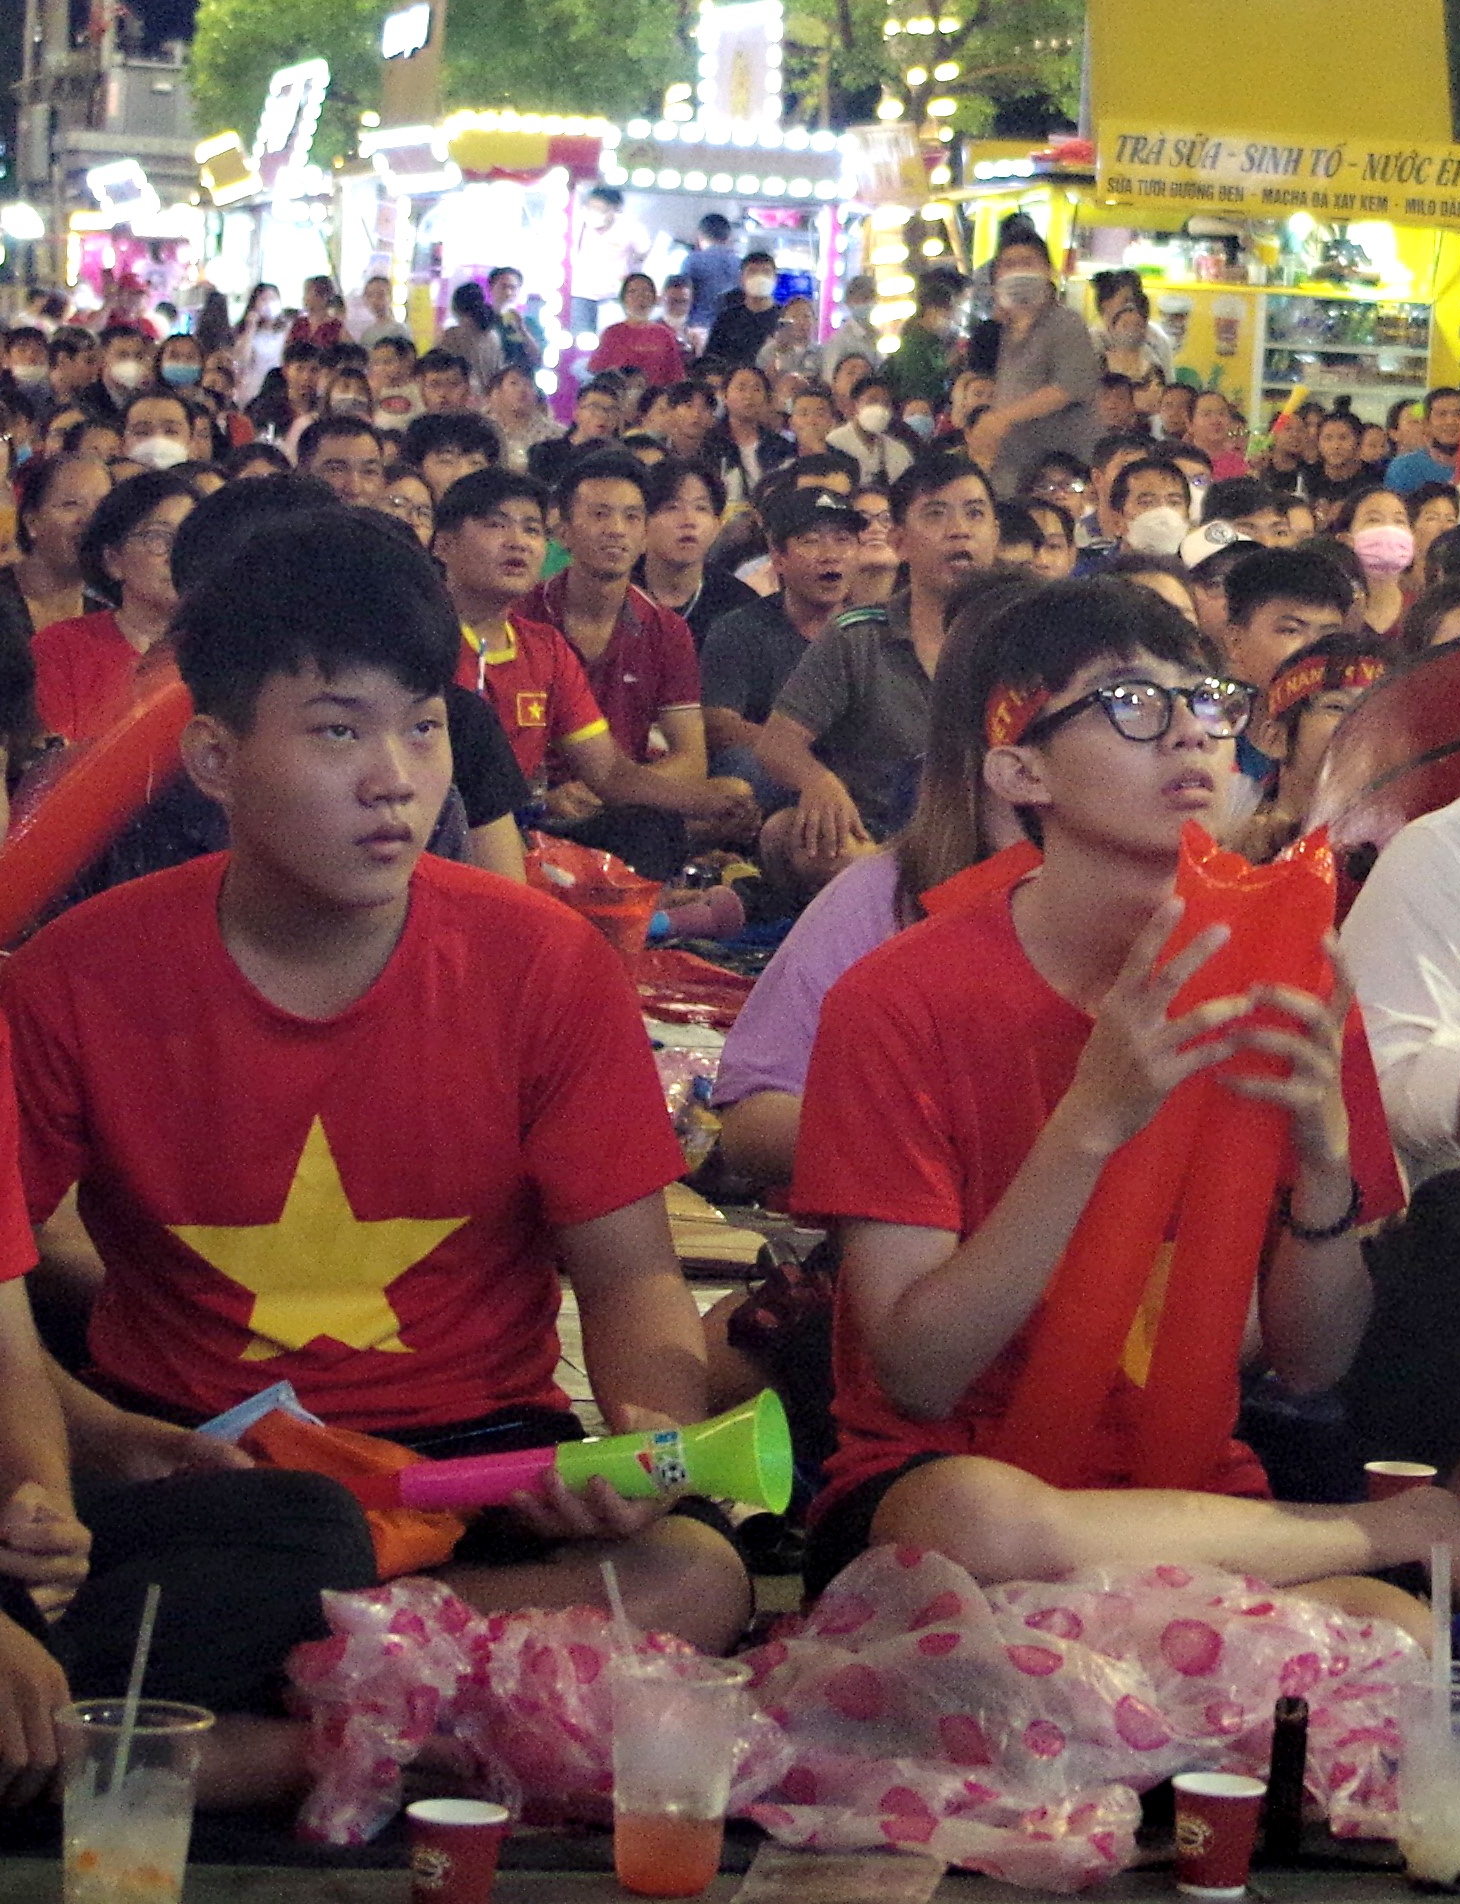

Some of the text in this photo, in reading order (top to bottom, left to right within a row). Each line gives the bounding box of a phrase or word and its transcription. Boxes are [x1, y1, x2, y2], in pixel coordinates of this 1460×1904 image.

[1115, 131, 1166, 166] TRÀ
[1241, 142, 1304, 176] SINH
[1309, 142, 1347, 178] TỐ
